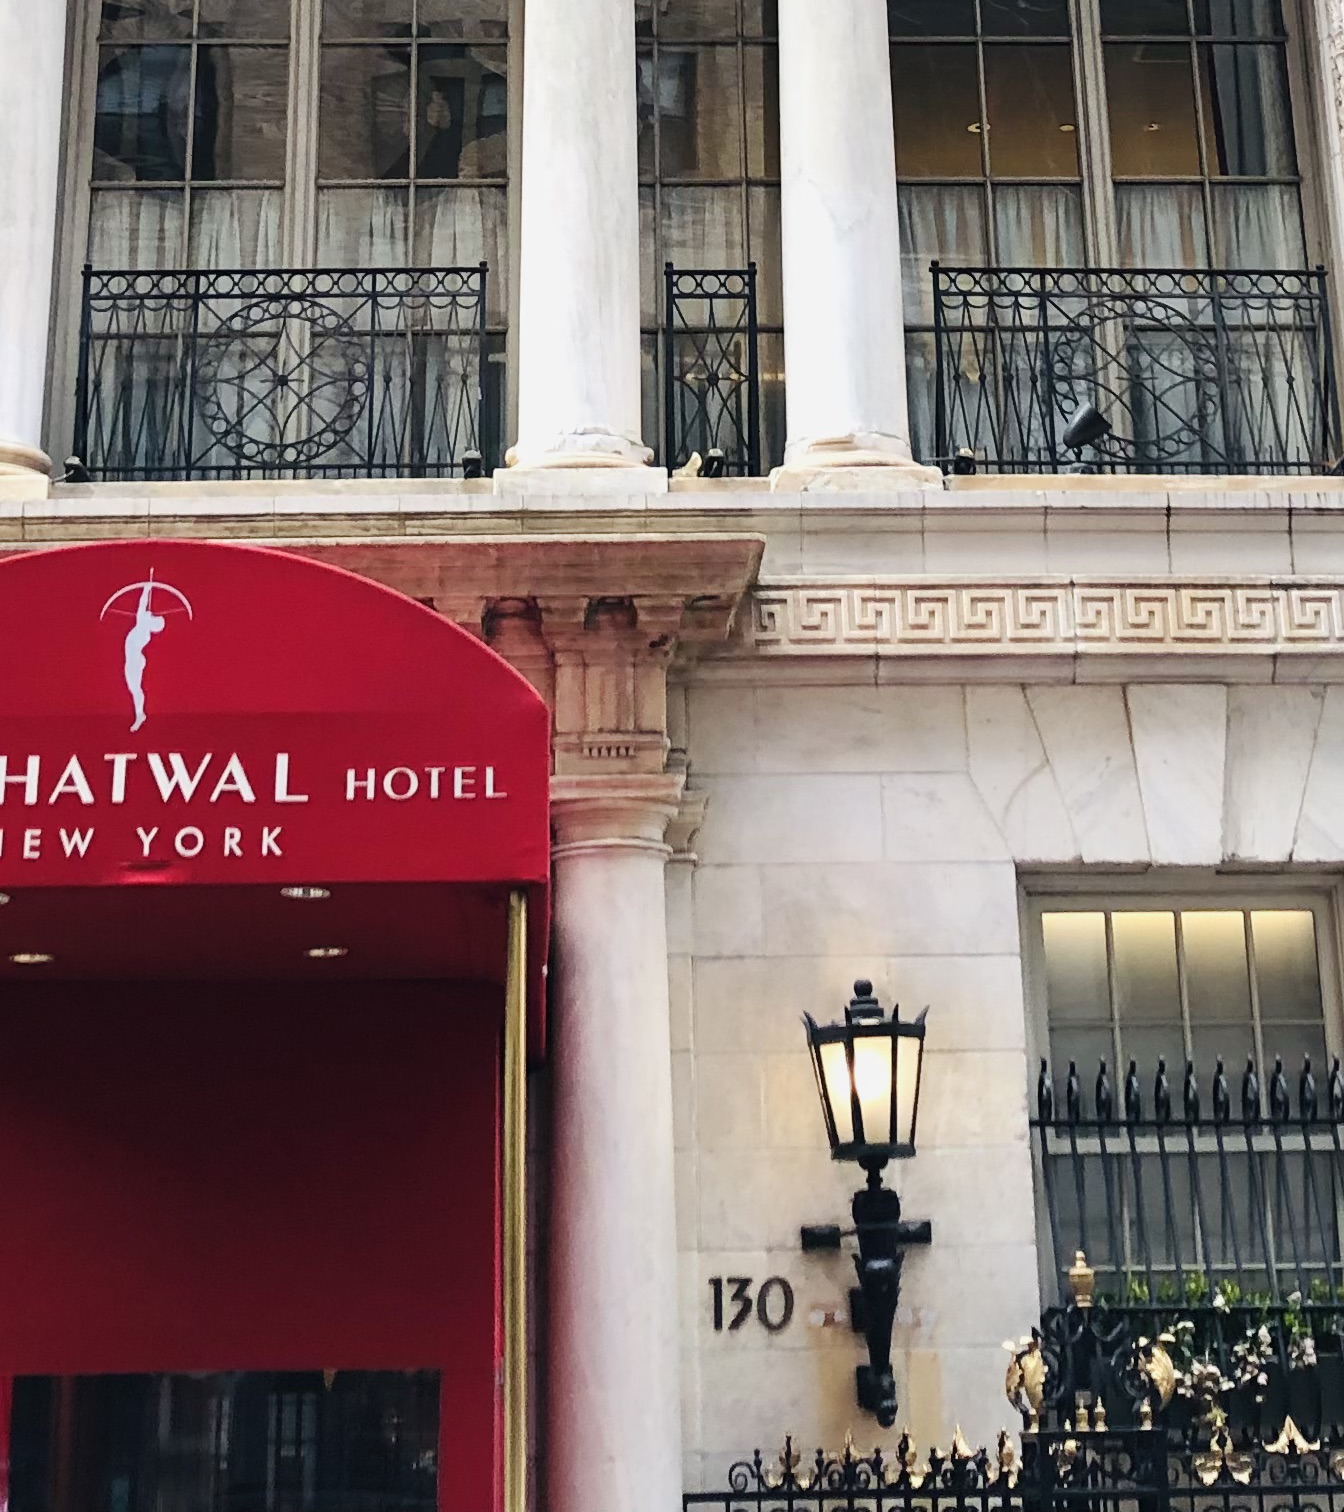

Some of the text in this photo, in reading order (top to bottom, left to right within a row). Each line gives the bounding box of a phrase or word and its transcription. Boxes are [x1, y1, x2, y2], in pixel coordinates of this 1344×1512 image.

[345, 766, 507, 801] HOTEL
[136, 826, 284, 857] YORK
[709, 1276, 795, 1331] 130
